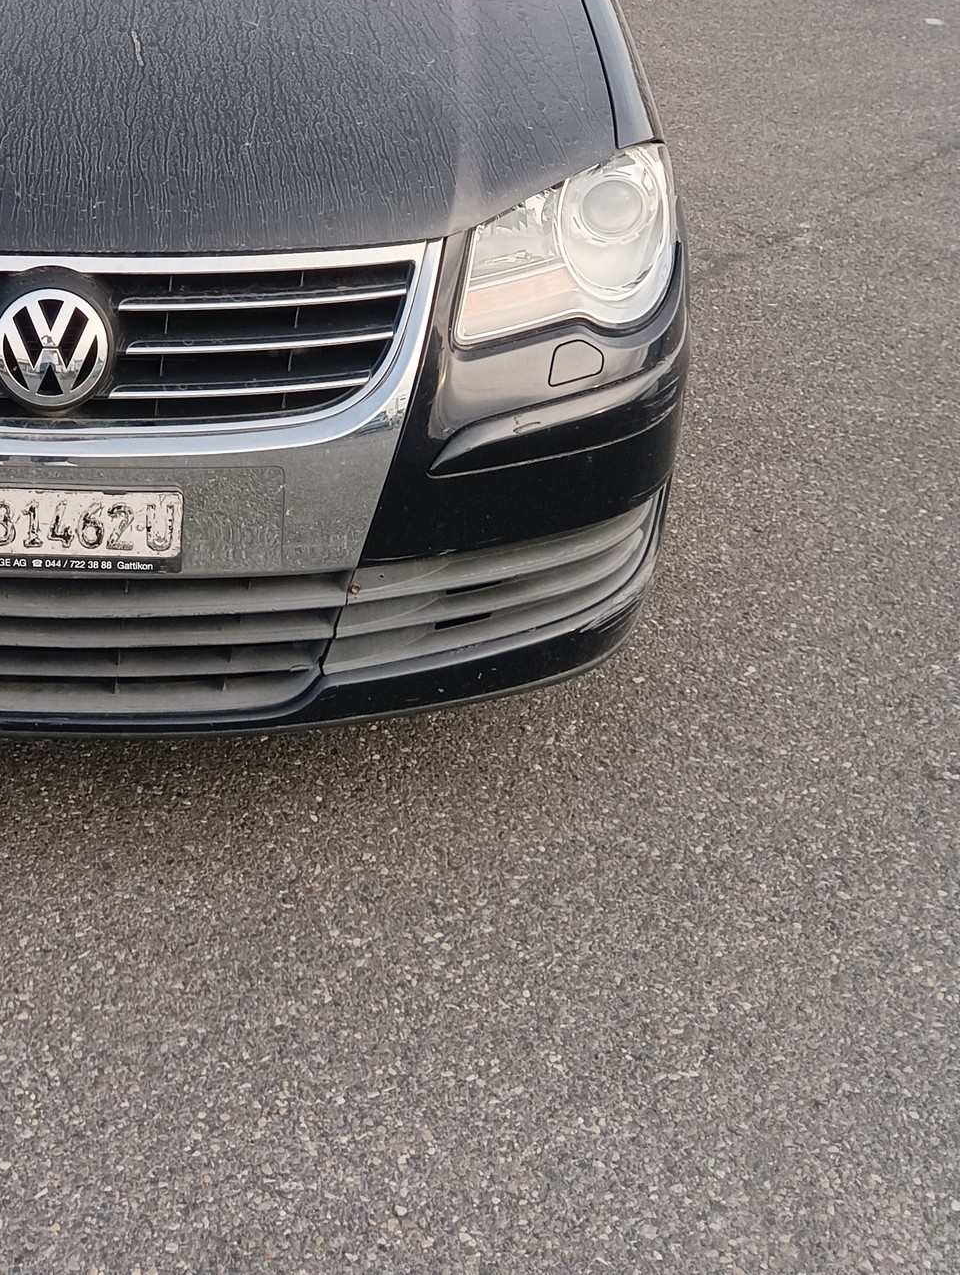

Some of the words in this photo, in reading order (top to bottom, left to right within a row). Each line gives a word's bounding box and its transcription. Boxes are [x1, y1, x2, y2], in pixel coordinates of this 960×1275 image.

[13, 558, 27, 568] AG
[44, 559, 62, 569] 044
[70, 559, 86, 570] 722
[88, 560, 99, 570] 38
[100, 561, 112, 571] 88
[116, 561, 154, 572] Gattikon
